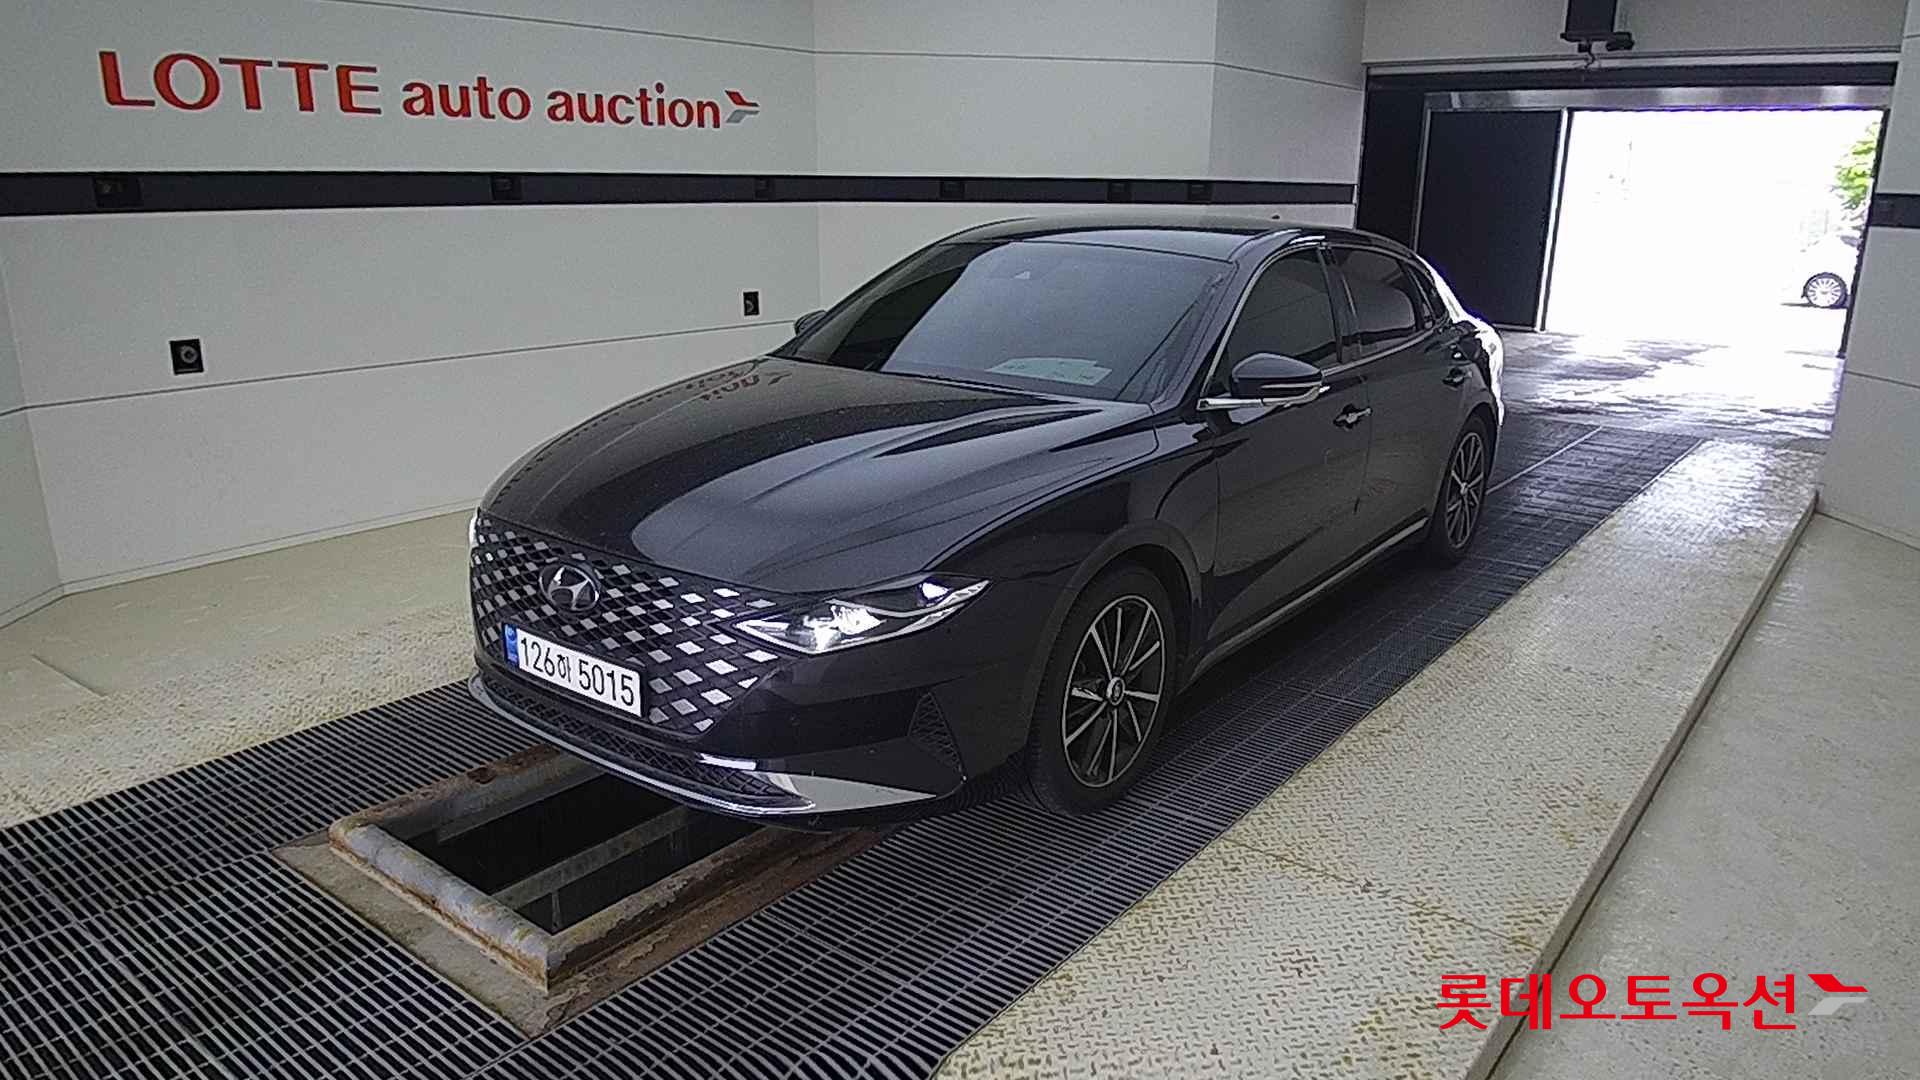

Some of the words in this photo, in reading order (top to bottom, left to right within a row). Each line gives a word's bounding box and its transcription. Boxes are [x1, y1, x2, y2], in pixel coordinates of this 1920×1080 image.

[99, 51, 381, 115] LOTTE
[403, 78, 532, 120] auto
[548, 83, 722, 129] auction
[520, 637, 572, 683] 126하
[578, 658, 634, 706] 5015
